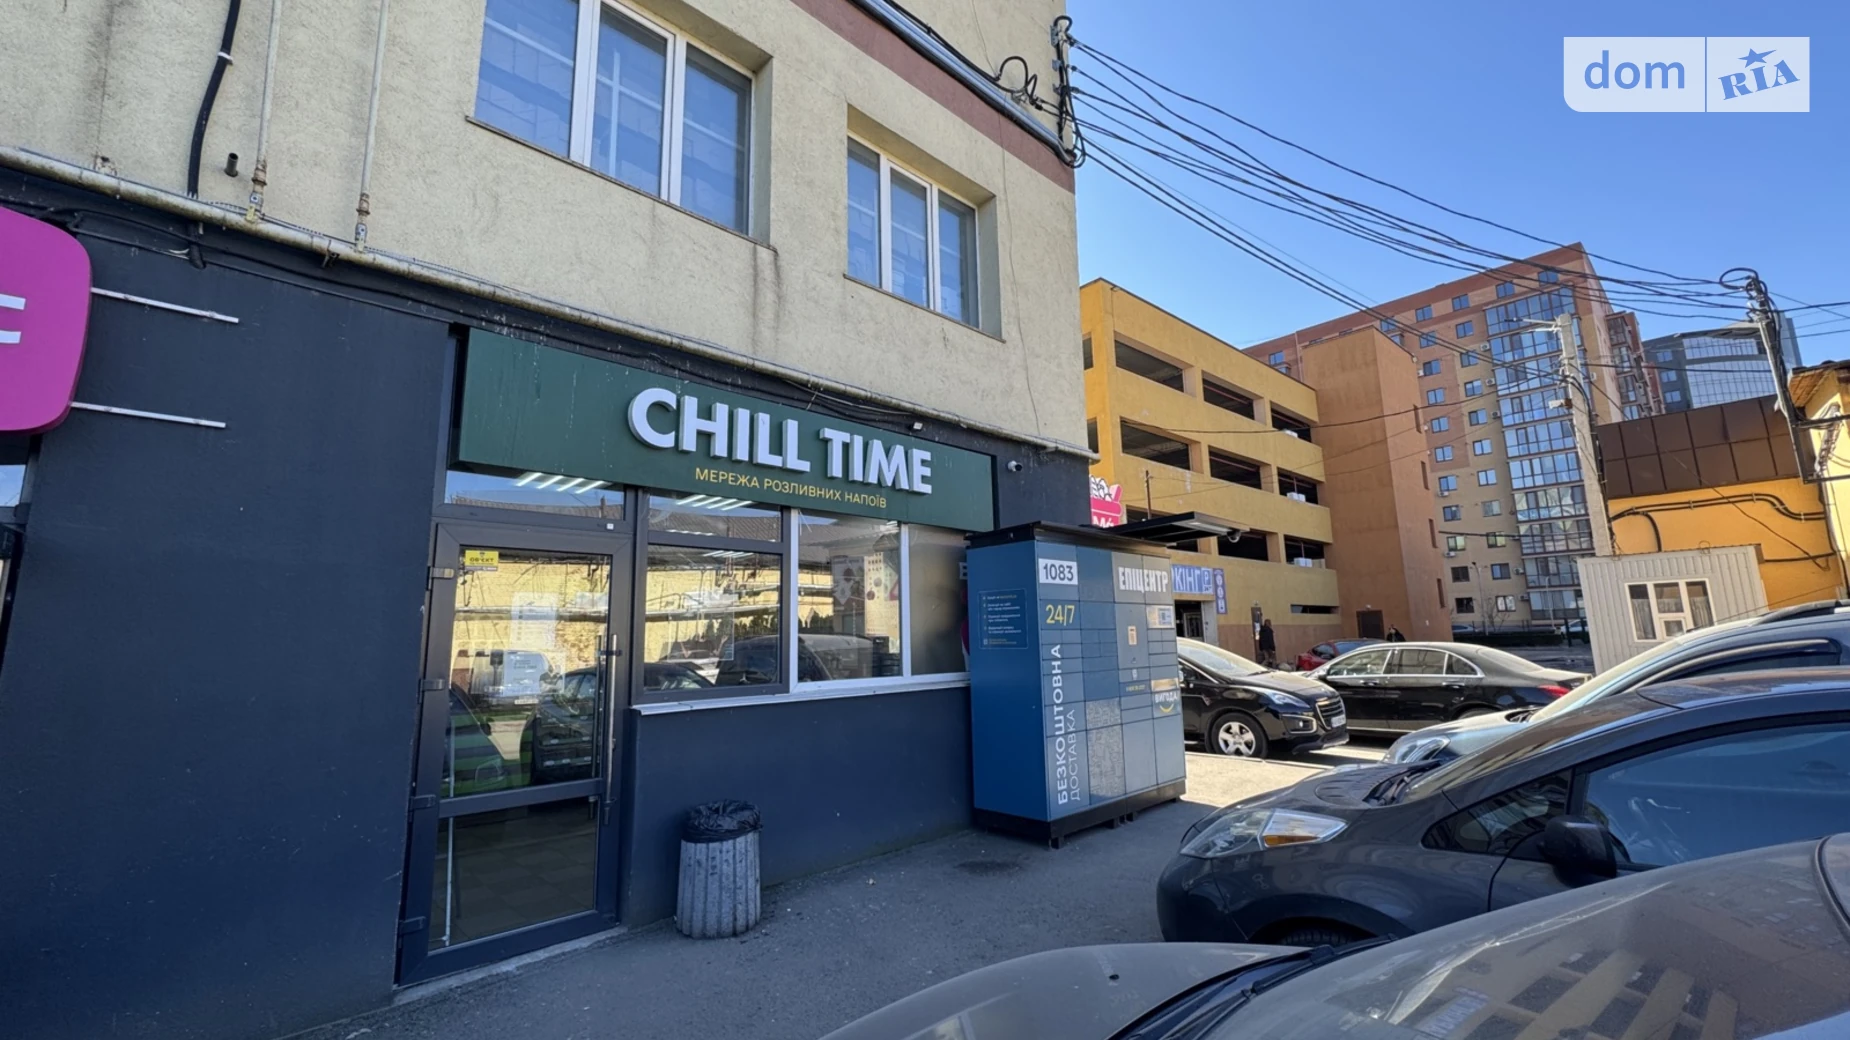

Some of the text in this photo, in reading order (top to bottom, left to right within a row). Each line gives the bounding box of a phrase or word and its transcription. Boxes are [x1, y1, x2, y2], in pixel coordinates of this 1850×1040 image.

[627, 387, 933, 495] CHILL TIME
[695, 467, 888, 509] МЕРЕЖА РОЗЛИВНИХ НАПОЇВ
[1043, 562, 1075, 582] 1083
[1118, 567, 1169, 594] ЕПІЦЕНТР
[1171, 567, 1200, 592] КІНГ
[1045, 604, 1075, 626] 24/7
[1154, 691, 1178, 703] ВИГОДА
[1051, 644, 1069, 805] БЕЗКОШТОВНА
[1067, 709, 1081, 801] ДОСТАВКА
